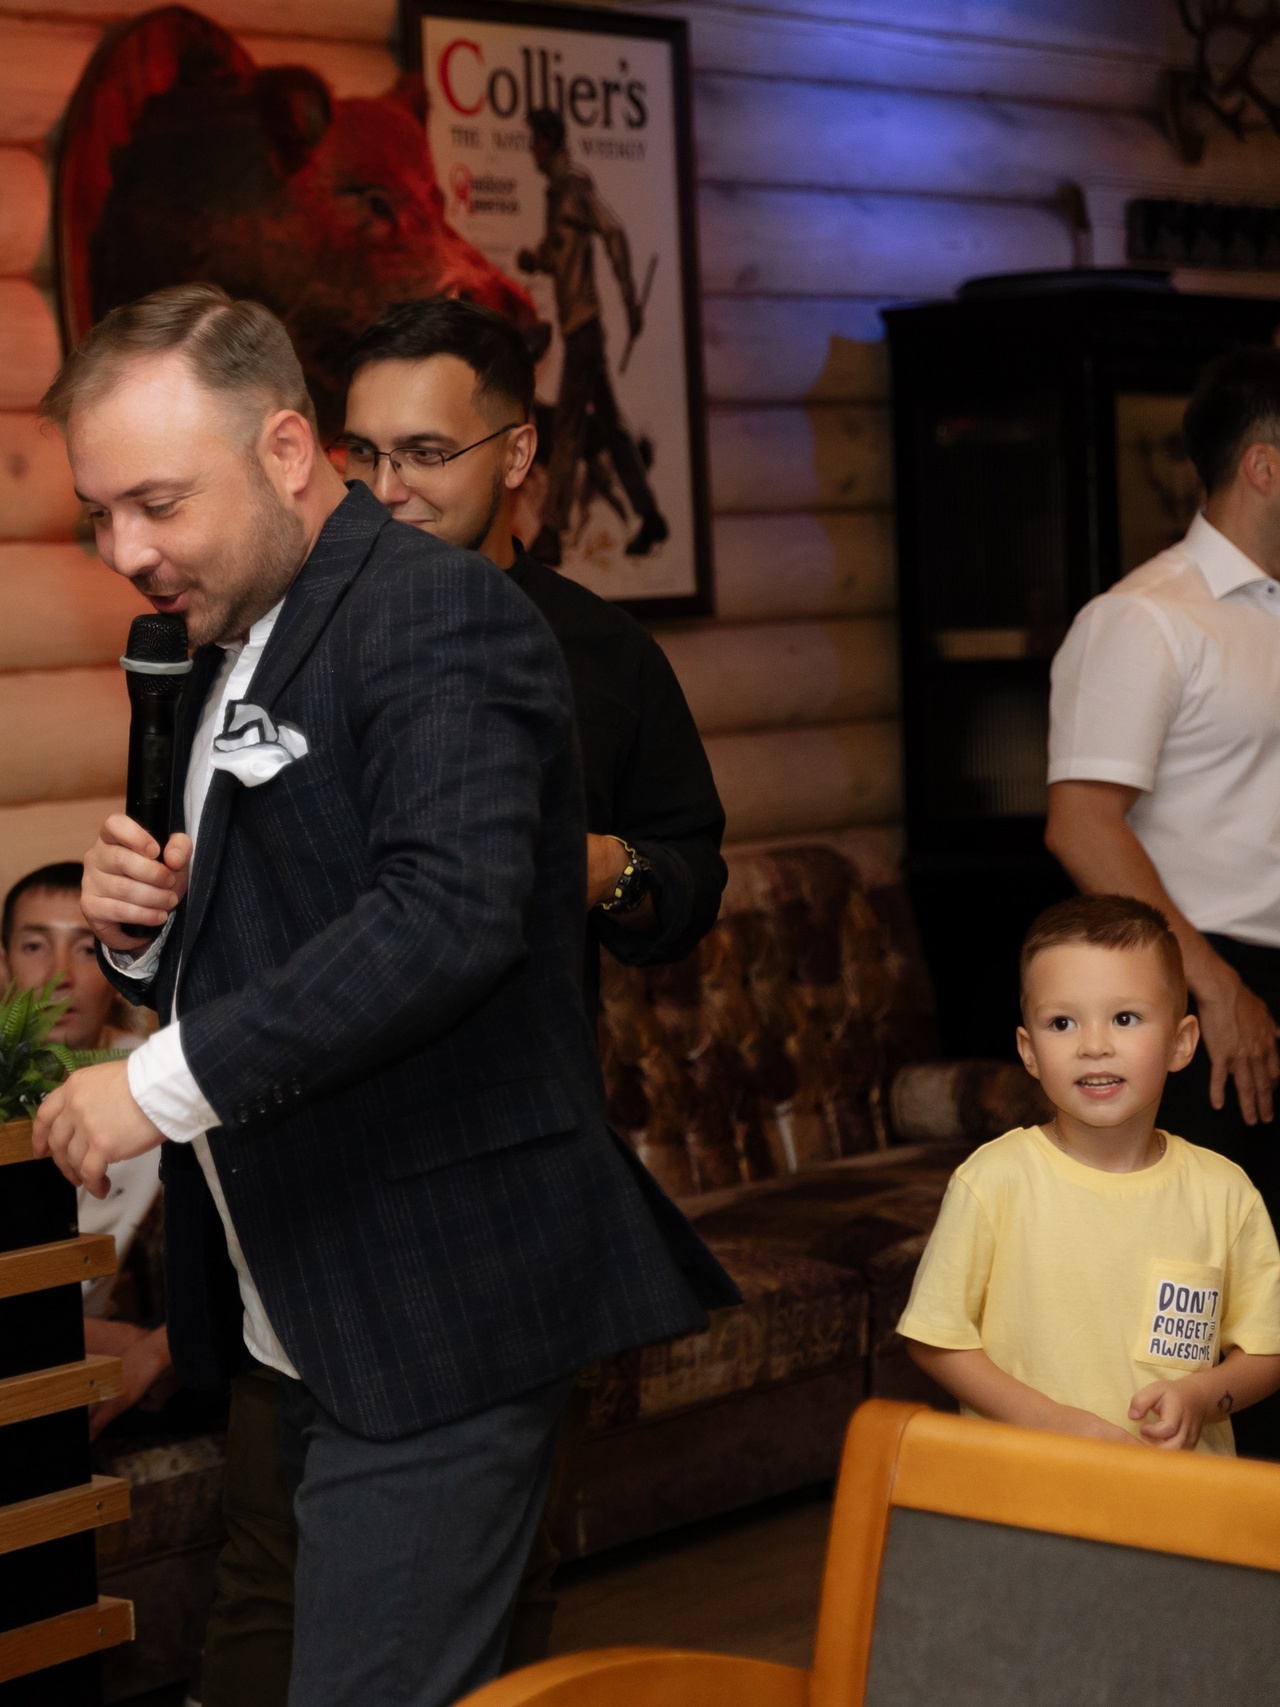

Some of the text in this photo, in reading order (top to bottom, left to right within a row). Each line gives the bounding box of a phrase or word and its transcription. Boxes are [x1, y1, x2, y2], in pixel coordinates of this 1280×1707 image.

[437, 38, 648, 130] Collier's
[1159, 1282, 1218, 1317] DON'T
[1153, 1315, 1209, 1340] FORGET
[1150, 1338, 1210, 1361] AWESOME
